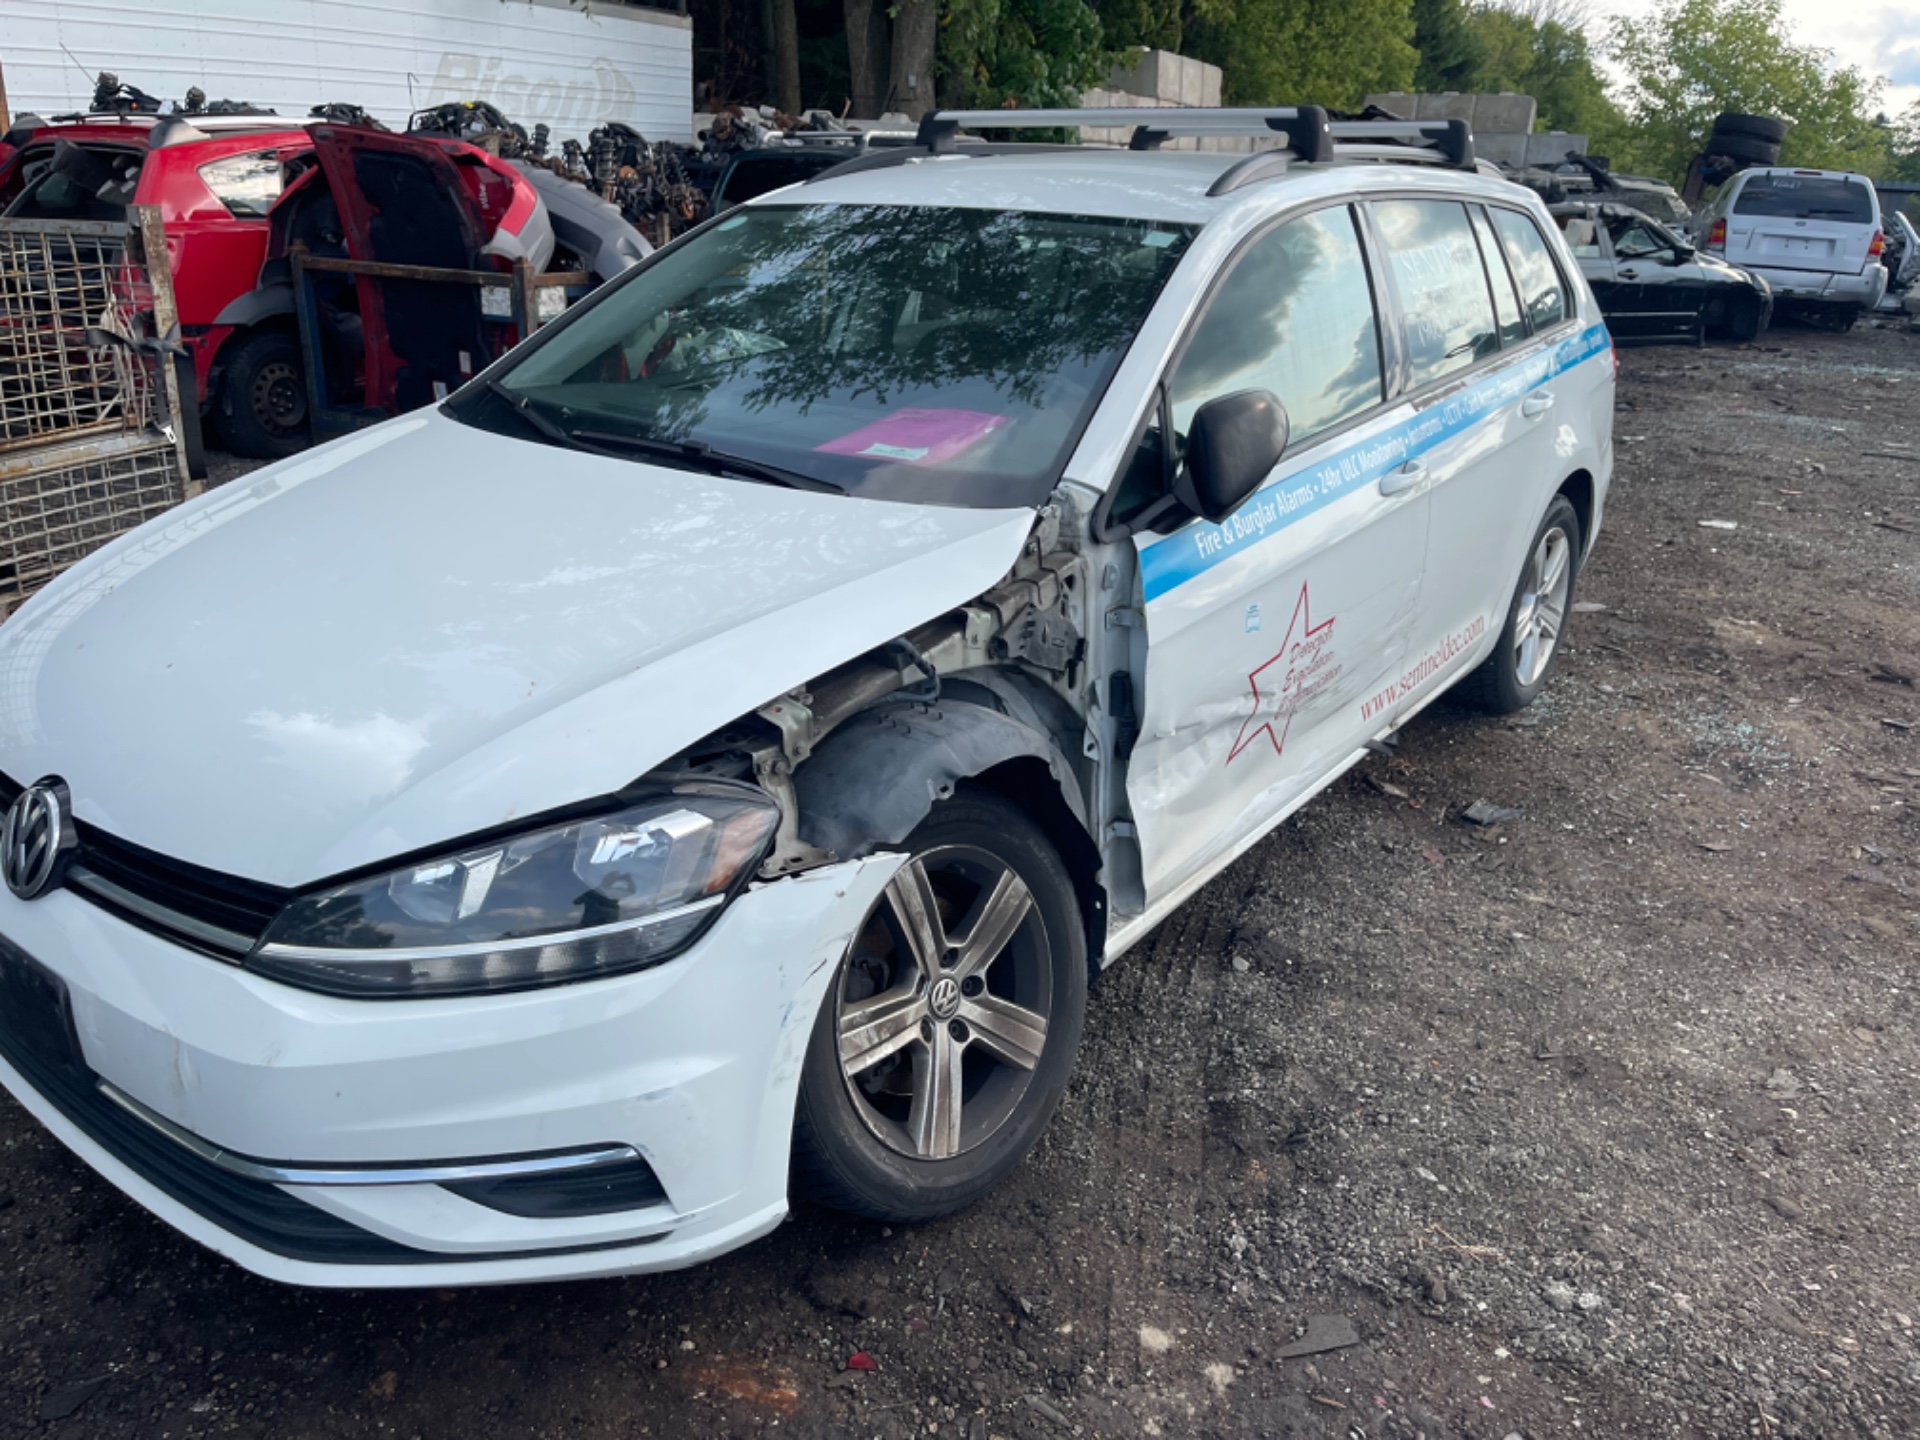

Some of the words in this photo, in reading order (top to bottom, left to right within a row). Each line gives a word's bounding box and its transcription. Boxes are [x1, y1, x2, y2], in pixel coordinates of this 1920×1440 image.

[426, 52, 596, 125] Bison
[1194, 531, 1222, 559] Fire
[1220, 522, 1235, 546] &
[1233, 502, 1277, 535] Burglar
[1276, 483, 1315, 516] Alarms
[1317, 465, 1342, 494] 24hr
[1341, 457, 1359, 482] ULC
[1358, 435, 1408, 473] Monitoring
[1289, 628, 1333, 665] Detection
[1359, 614, 1486, 722] www.sentineldec.com
